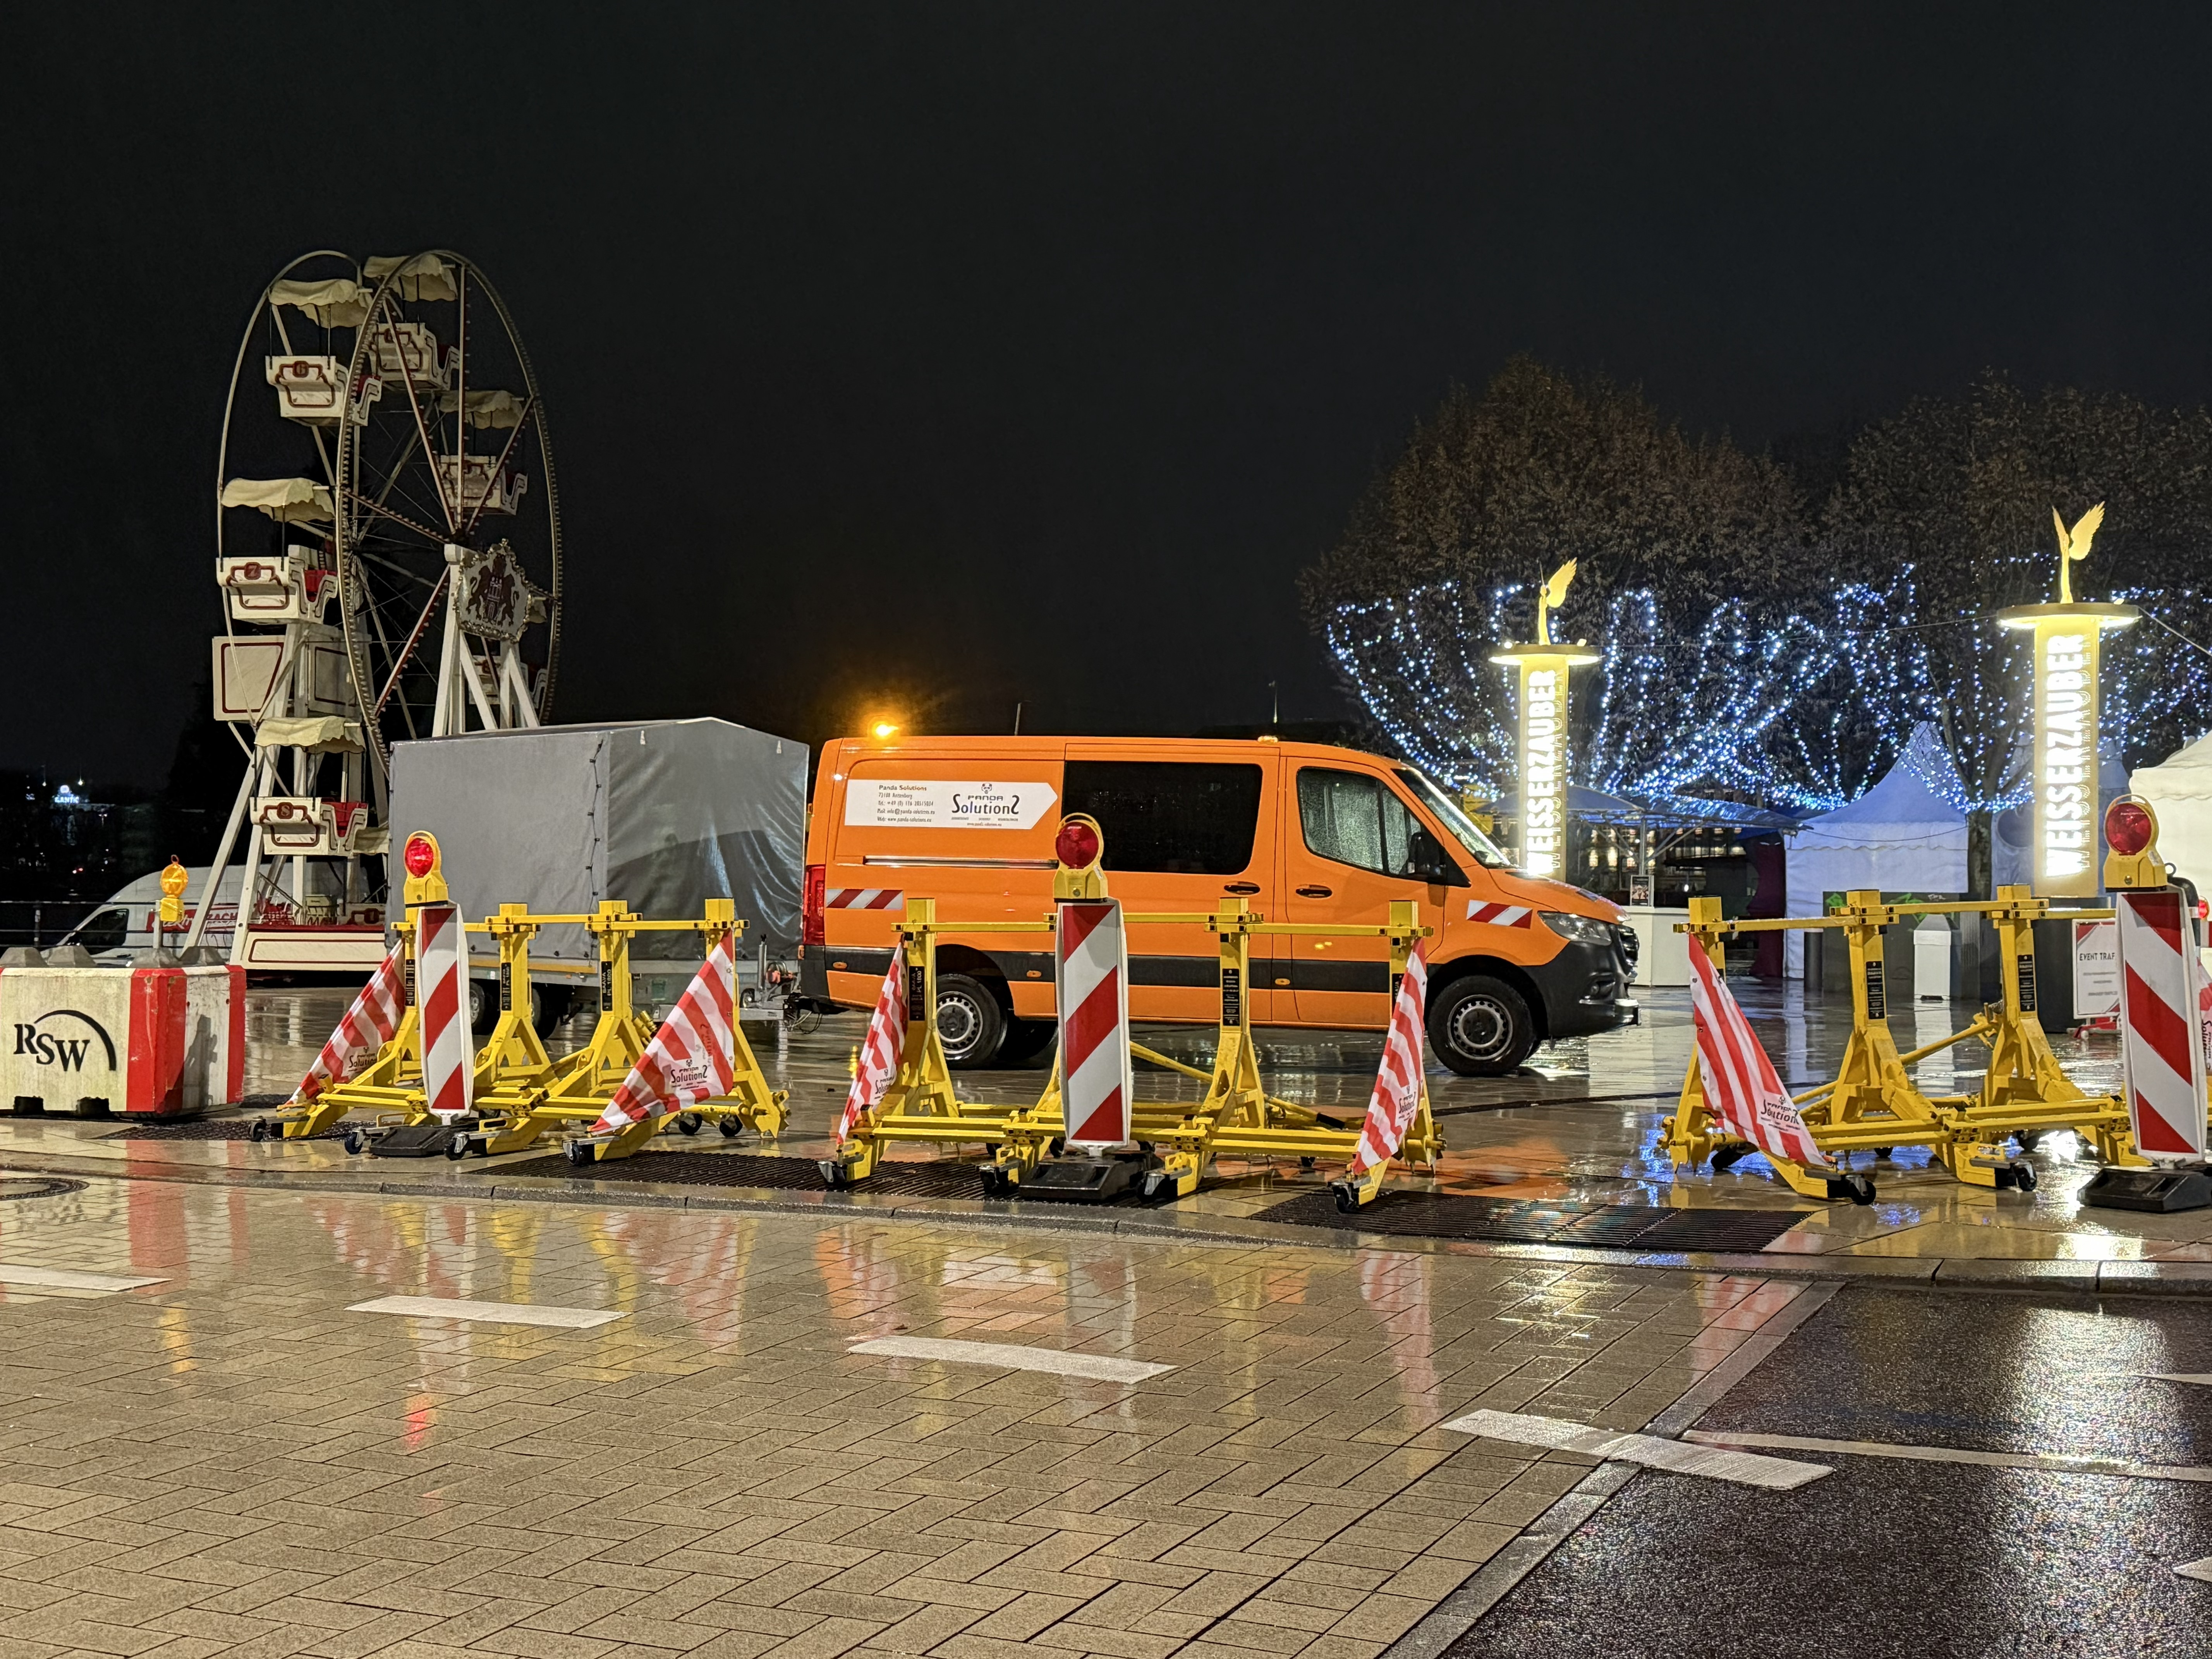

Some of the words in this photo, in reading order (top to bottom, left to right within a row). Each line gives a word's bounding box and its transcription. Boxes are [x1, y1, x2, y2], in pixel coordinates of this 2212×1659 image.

[297, 364, 306, 374] 6
[248, 565, 258, 576] 7
[2047, 635, 2083, 877] WEISSERZAUBER
[1527, 669, 1556, 876] WEISSERZAUBER
[2080, 953, 2098, 961] EVENT
[14, 1024, 91, 1072] RSW
